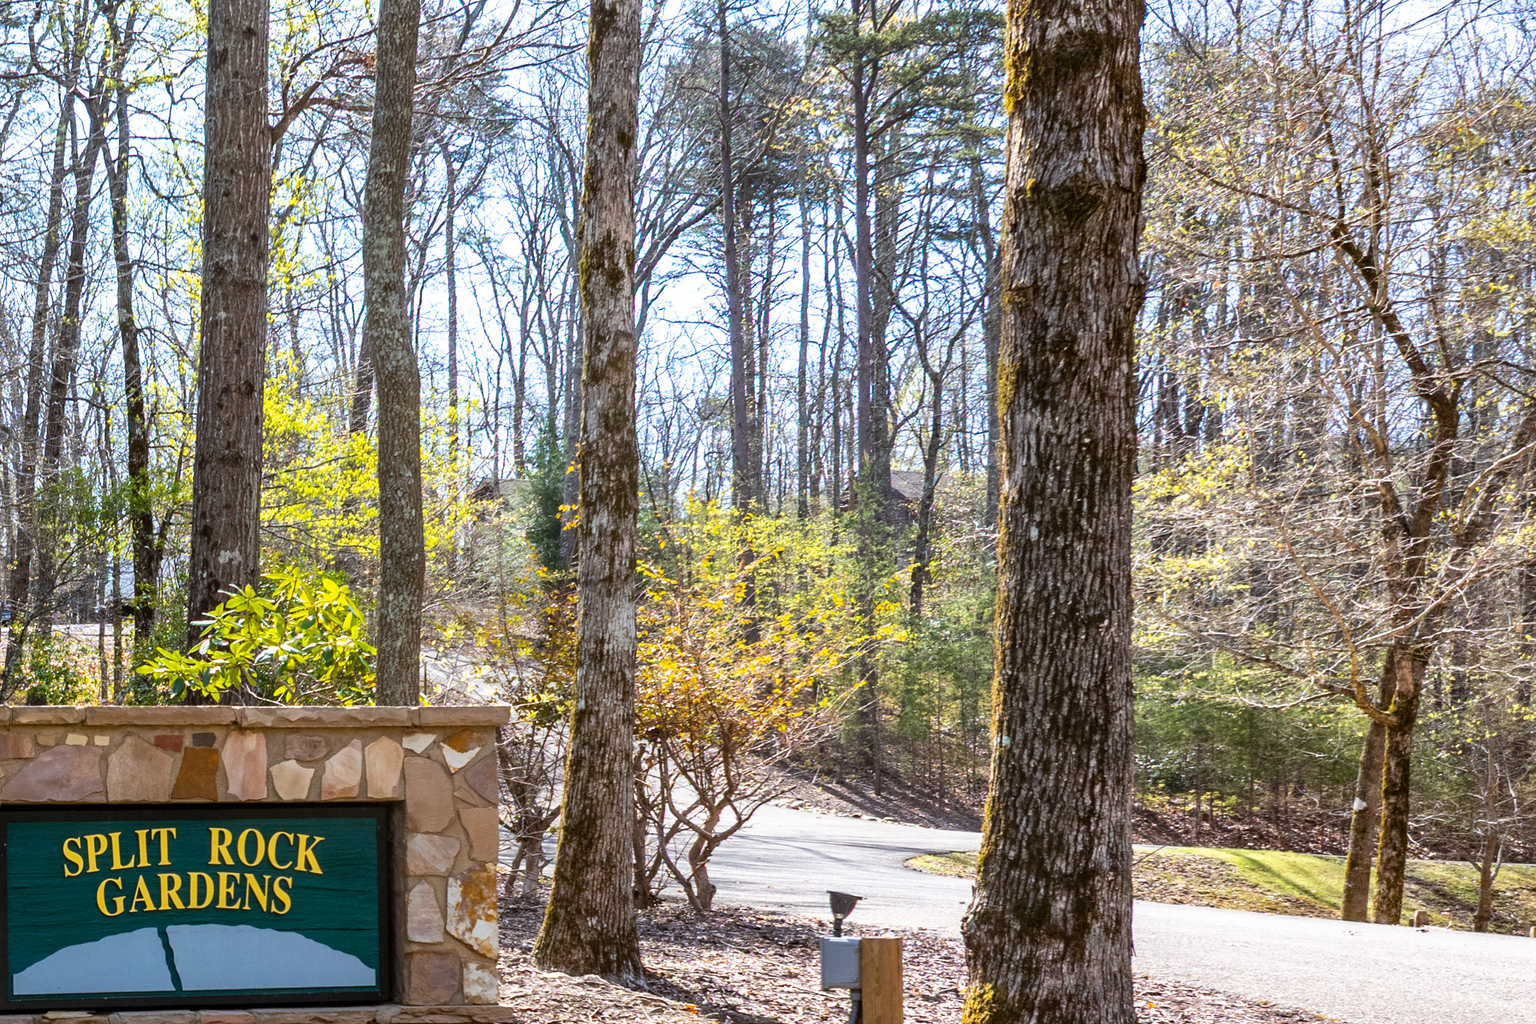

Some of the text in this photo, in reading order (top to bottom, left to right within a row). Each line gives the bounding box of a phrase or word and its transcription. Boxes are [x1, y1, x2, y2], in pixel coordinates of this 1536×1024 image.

[62, 827, 325, 878] SPLIT ROCK
[96, 871, 293, 917] GARDENS
